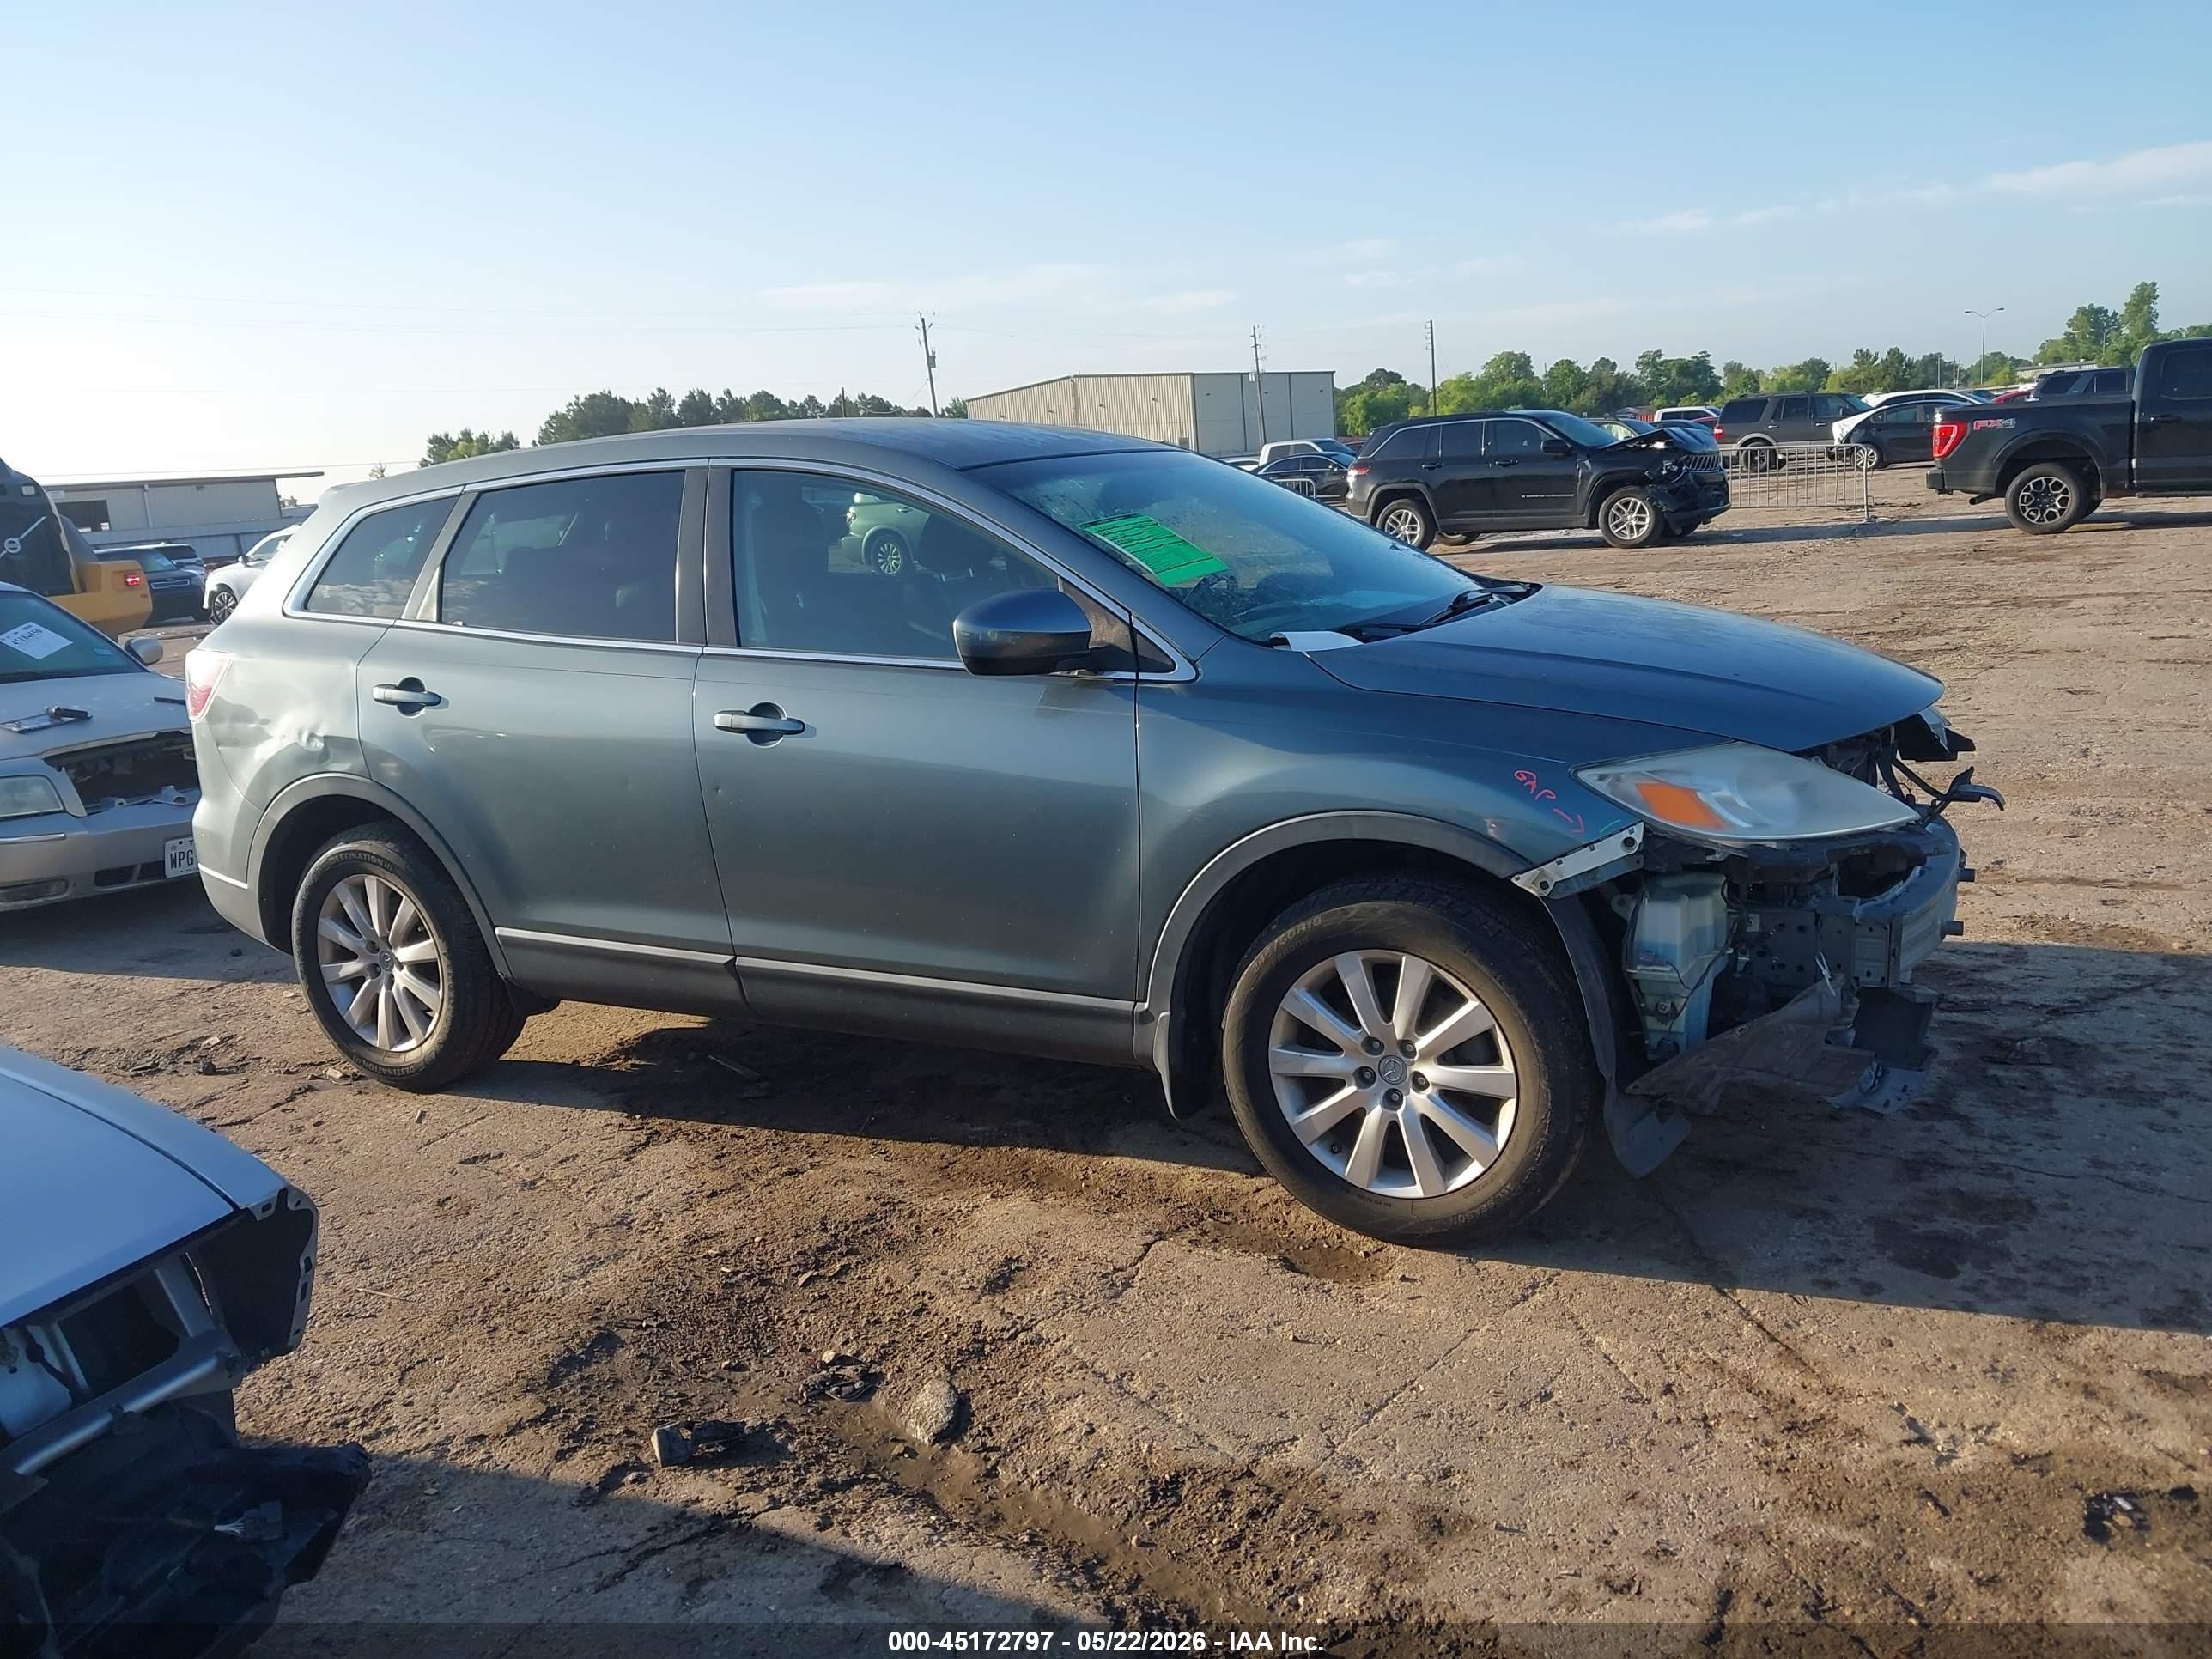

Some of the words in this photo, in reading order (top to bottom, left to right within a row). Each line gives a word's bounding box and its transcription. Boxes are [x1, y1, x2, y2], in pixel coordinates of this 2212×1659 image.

[1973, 418, 2016, 429] FX4
[170, 849, 193, 869] WPG
[330, 852, 384, 866] DESTINATION
[362, 1060, 416, 1075] DESTINATION
